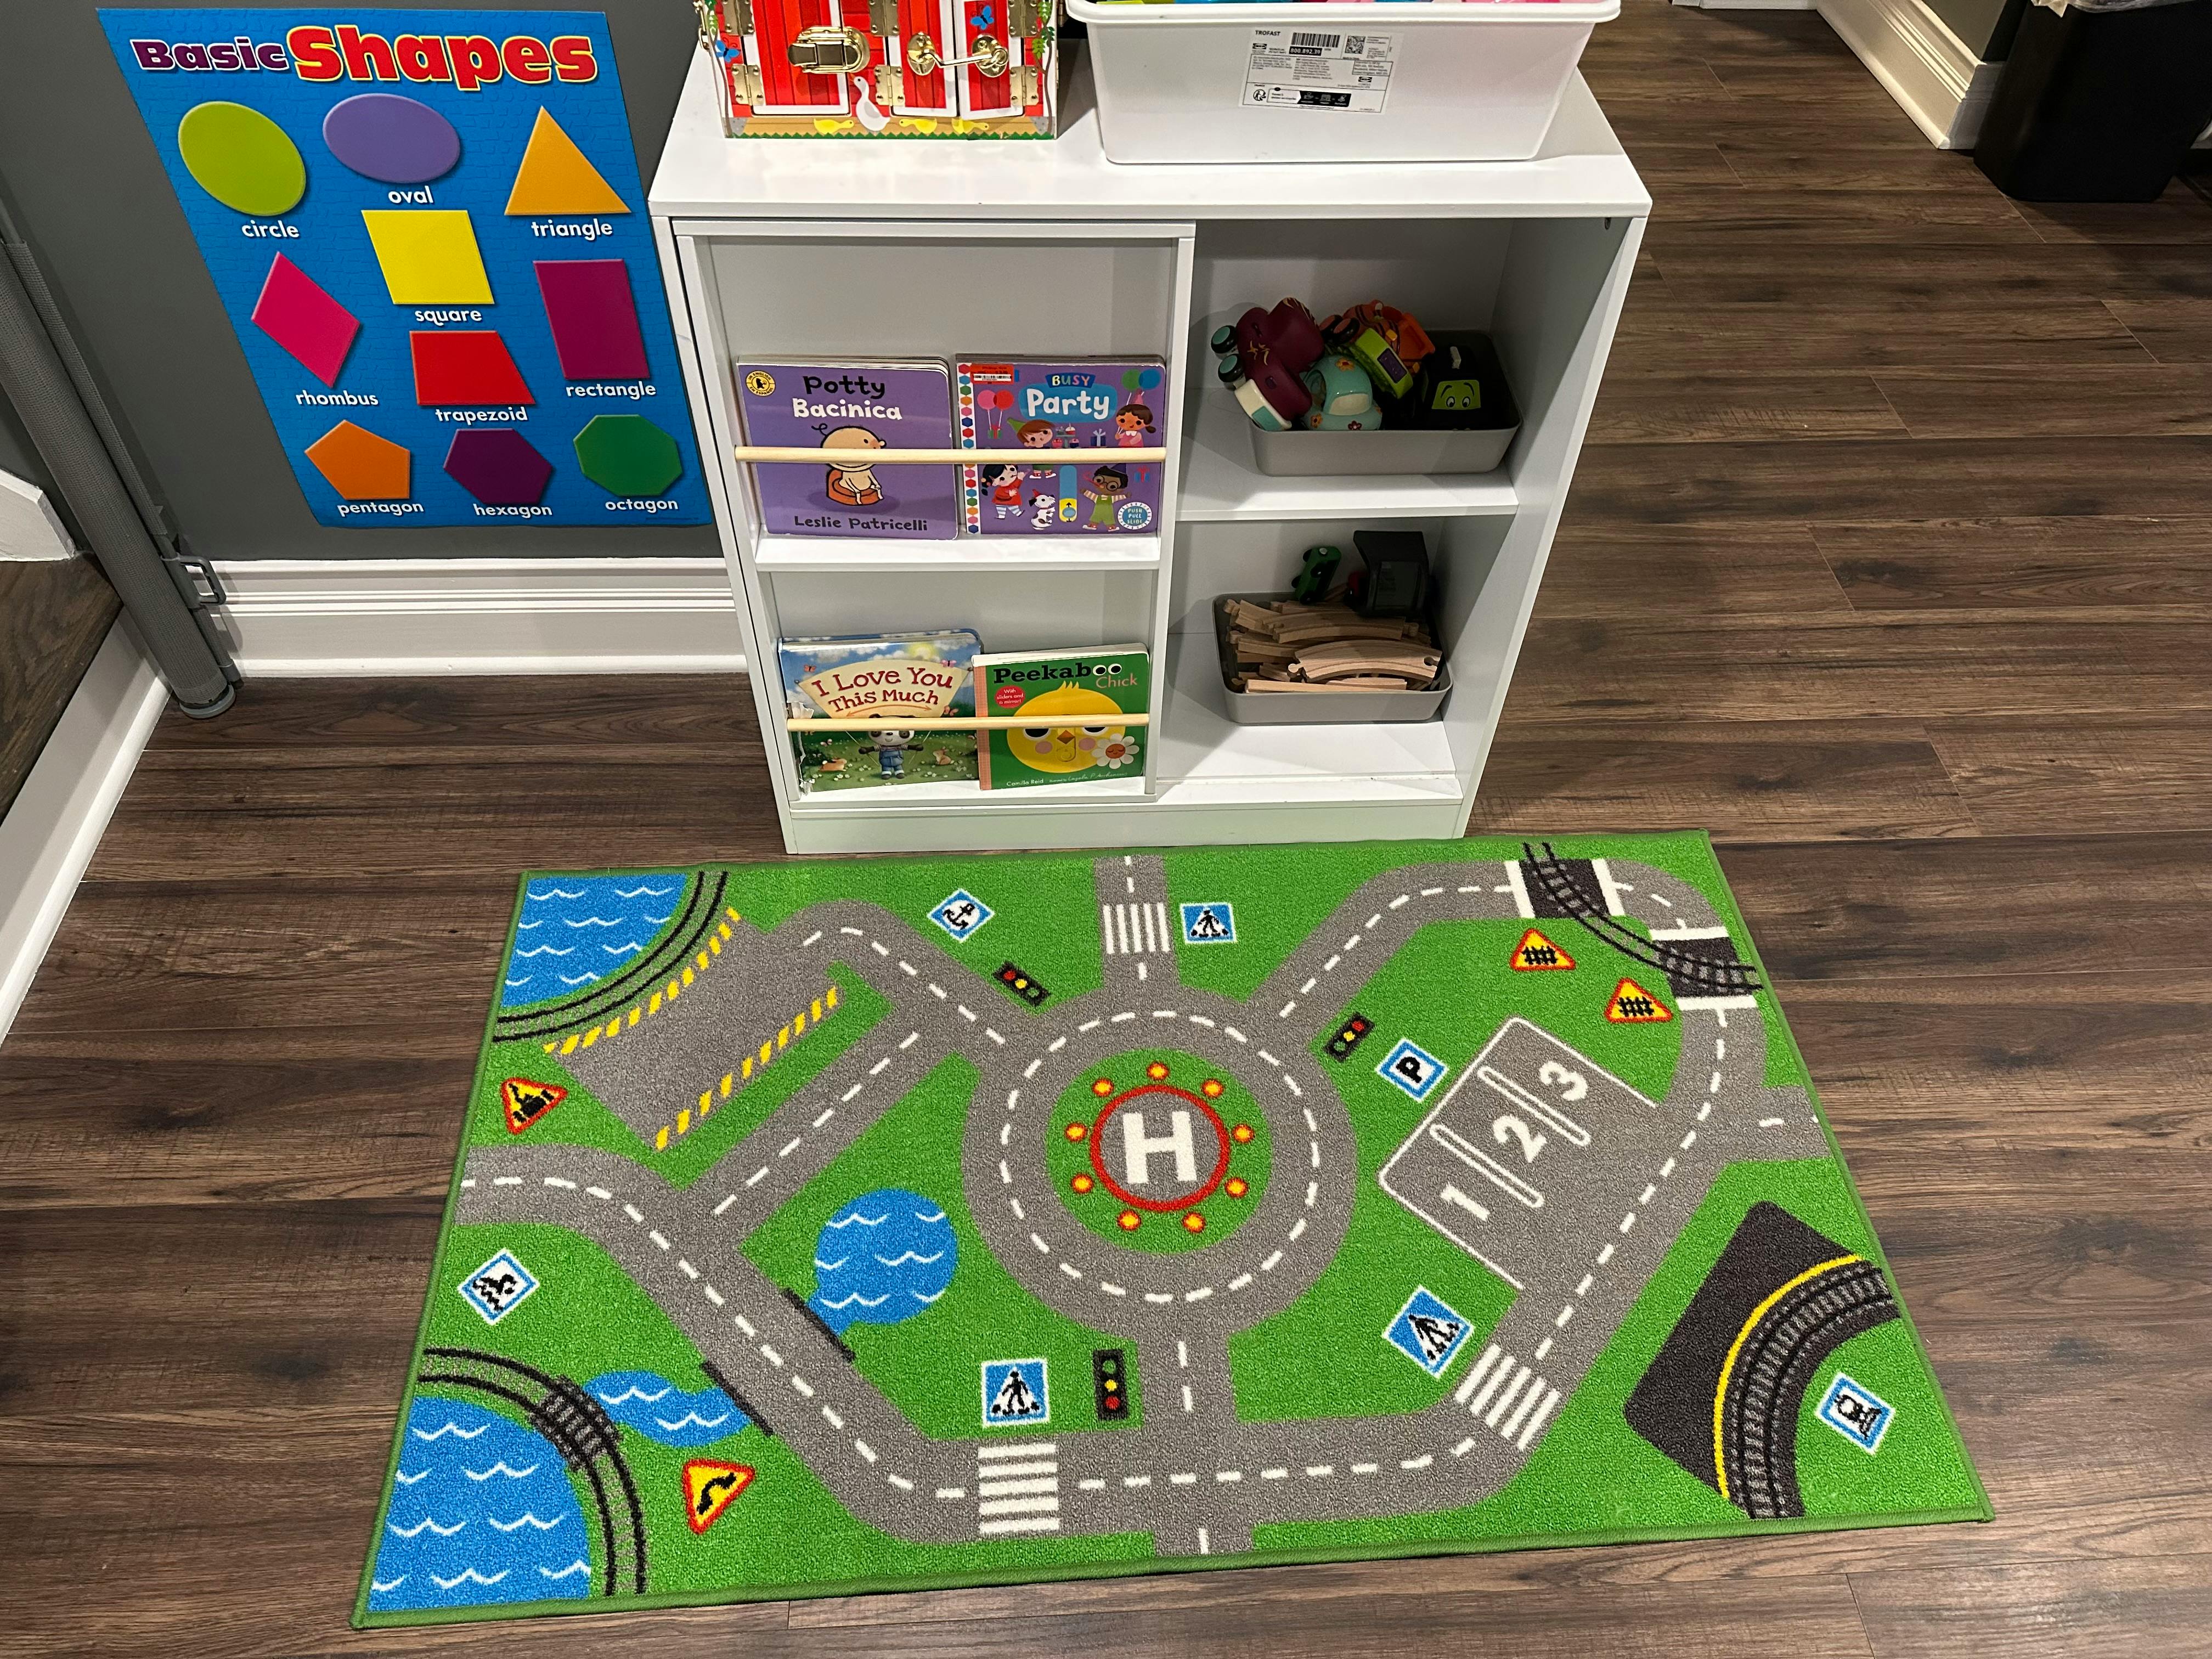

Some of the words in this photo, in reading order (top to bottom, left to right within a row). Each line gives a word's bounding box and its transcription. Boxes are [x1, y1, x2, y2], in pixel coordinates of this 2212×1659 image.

[129, 36, 289, 72] Basic
[286, 24, 598, 91] Shapes
[388, 185, 433, 205] oval
[241, 219, 300, 238] circle
[531, 219, 613, 240] triangle
[414, 307, 483, 325] square
[566, 381, 657, 400] rectangle
[803, 375, 885, 399] Potty
[1052, 375, 1090, 386] BUSY
[295, 390, 379, 407] rhombus
[792, 397, 902, 420] Bacinica
[1026, 388, 1109, 420] Party
[435, 407, 528, 425] trapezoid
[337, 499, 424, 517] pentagon
[473, 503, 552, 519] hexagon
[605, 498, 679, 514] octagon
[794, 516, 842, 528] Leslie
[849, 517, 927, 531] Patricelli
[812, 680, 830, 698] I
[833, 670, 901, 691] Love
[907, 667, 953, 689] You
[994, 663, 1122, 684] Peekaboo
[1096, 673, 1137, 689] Chick
[828, 691, 877, 712] This
[882, 689, 939, 705] Much
[1396, 1056, 1422, 1084] P
[1539, 1061, 1589, 1102] 3
[1122, 1110, 1197, 1184] H
[1492, 1115, 1547, 1163] 2
[1440, 1184, 1491, 1221] 1
